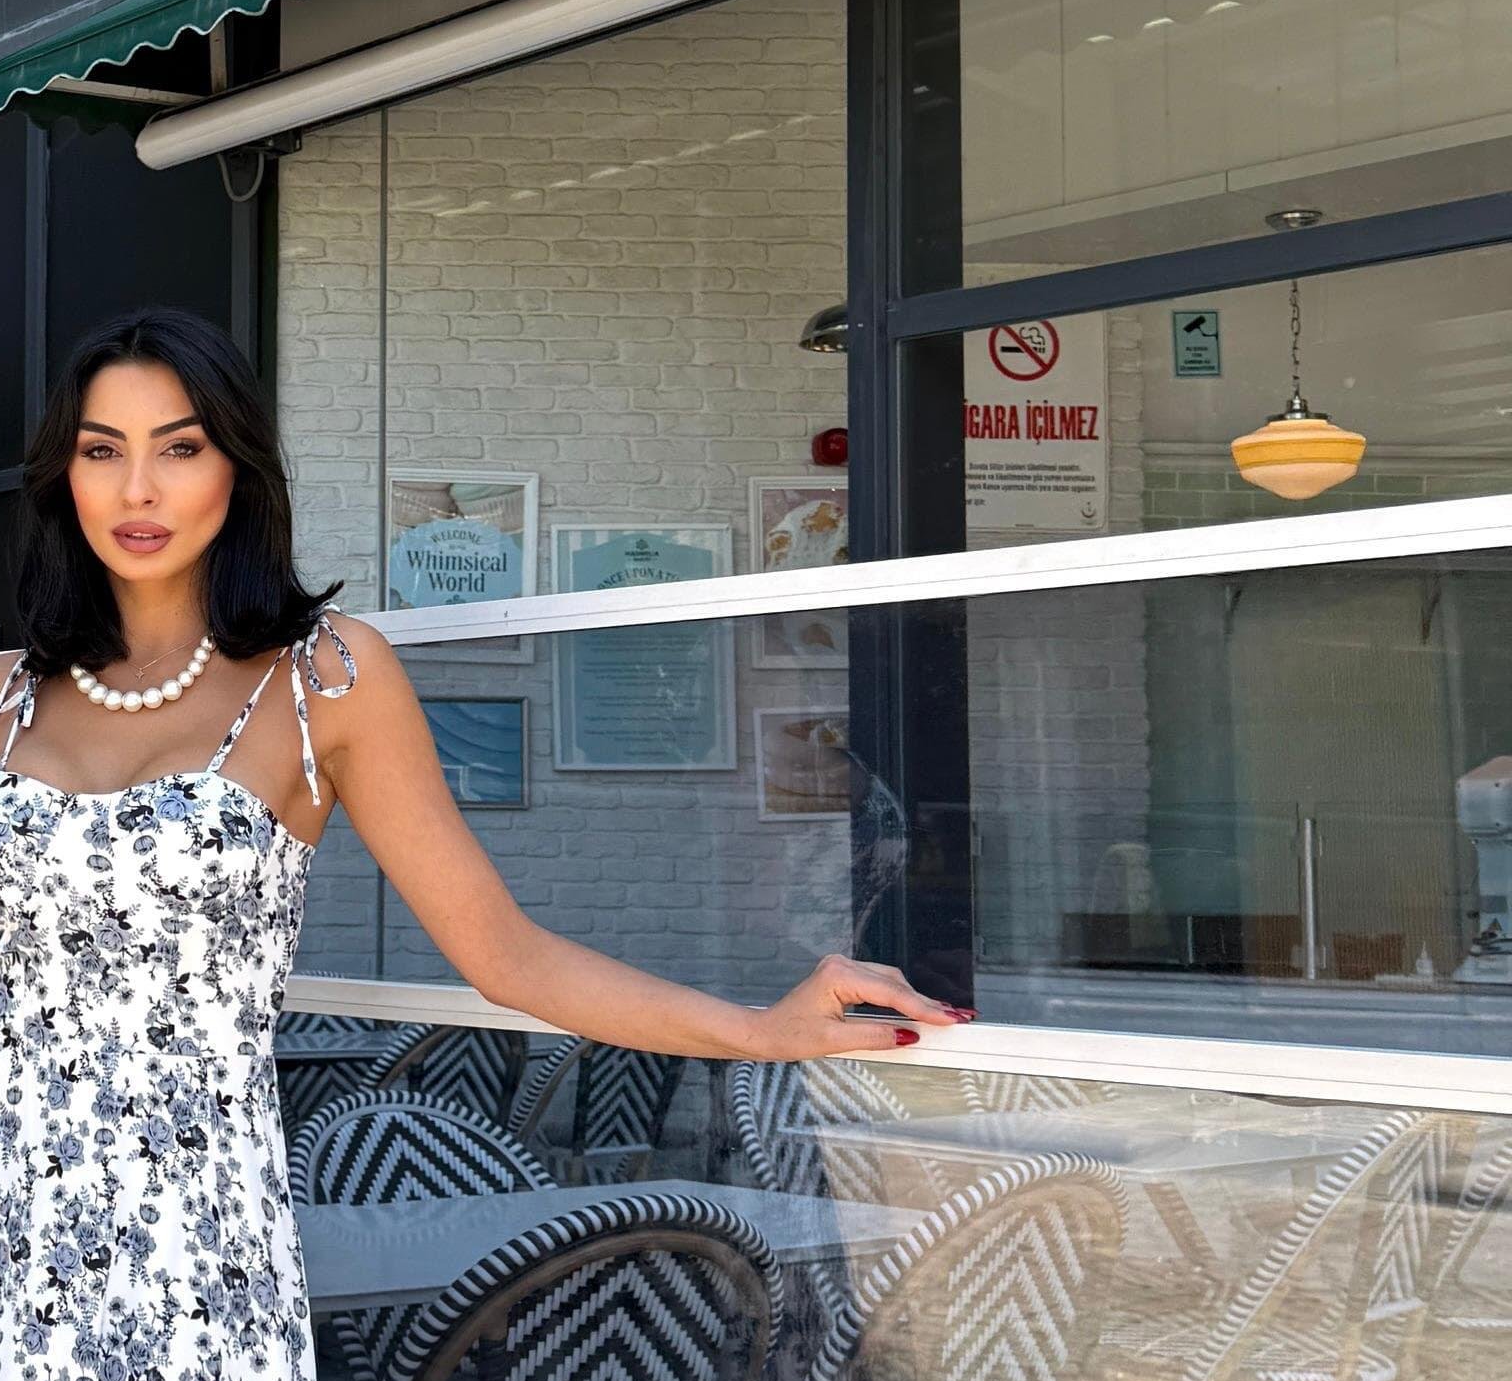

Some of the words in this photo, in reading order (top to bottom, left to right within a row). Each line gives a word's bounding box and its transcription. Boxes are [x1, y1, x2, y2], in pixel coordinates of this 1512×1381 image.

[963, 399, 1020, 440] İGARA
[1026, 399, 1099, 446] İÇİLMEZ
[406, 549, 507, 572] Whimsical
[428, 572, 485, 593] World
